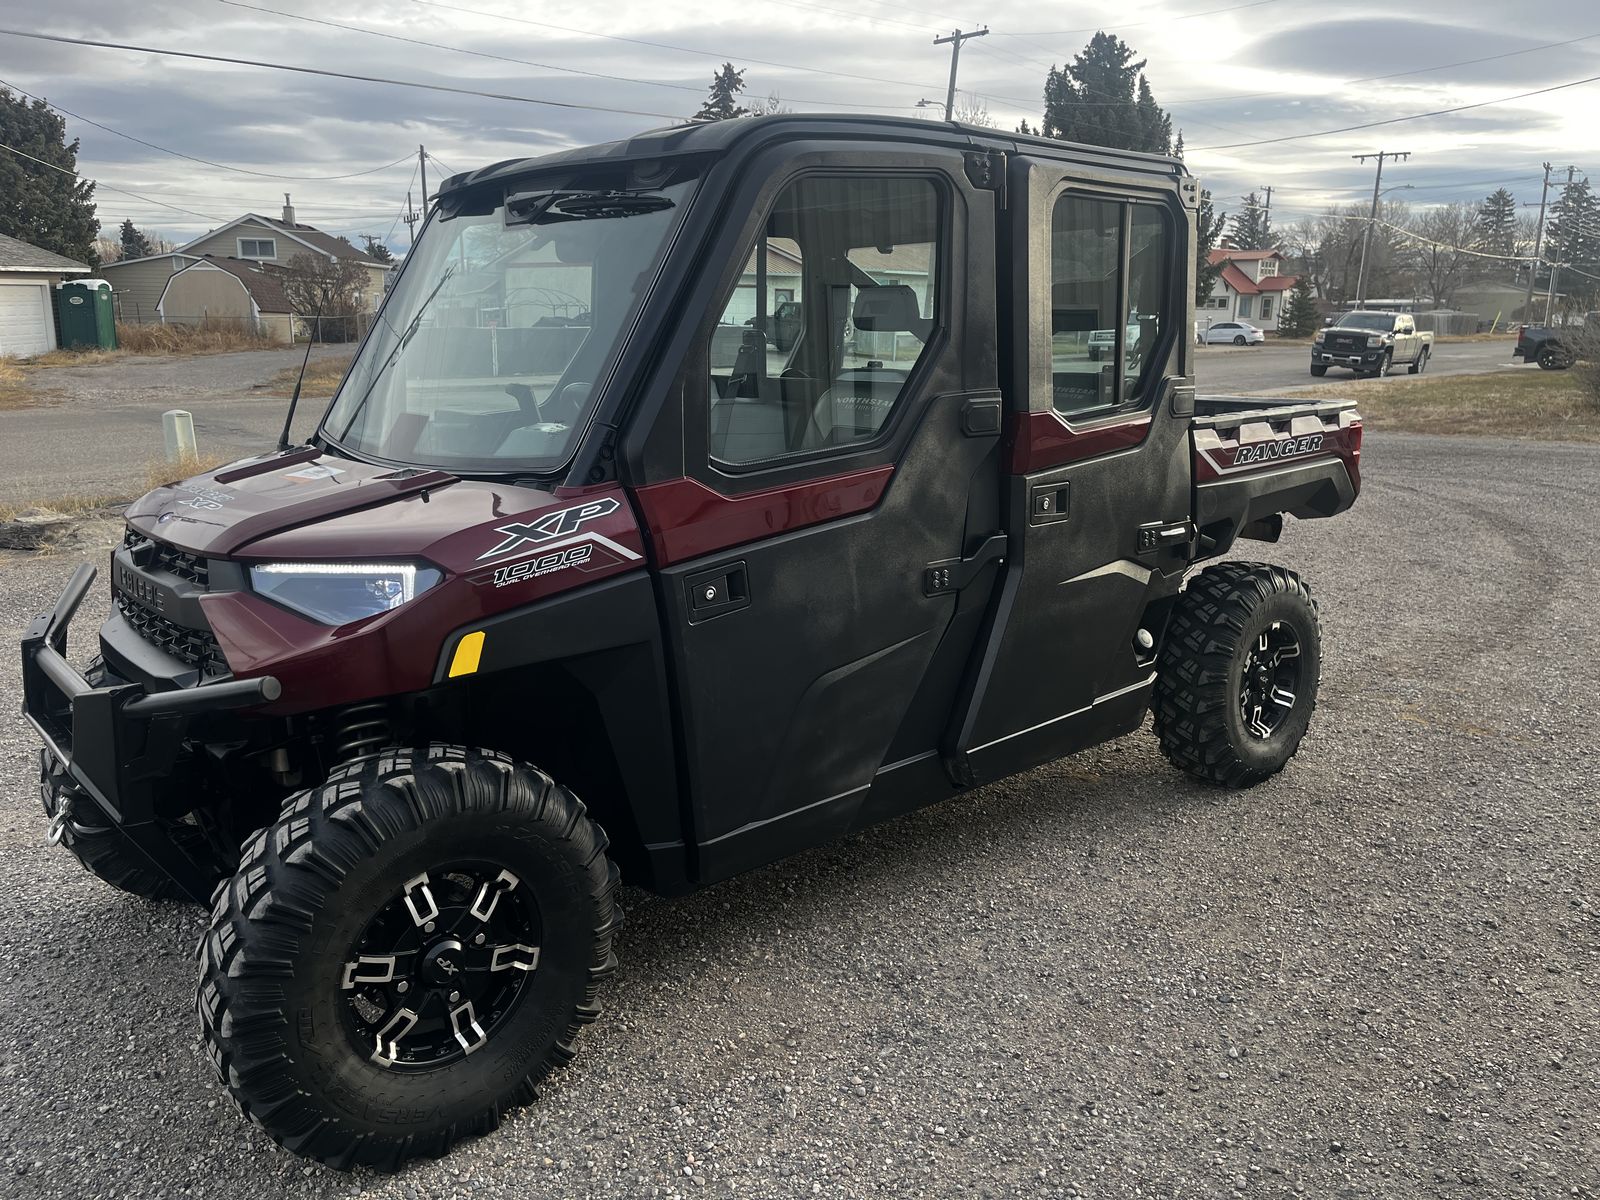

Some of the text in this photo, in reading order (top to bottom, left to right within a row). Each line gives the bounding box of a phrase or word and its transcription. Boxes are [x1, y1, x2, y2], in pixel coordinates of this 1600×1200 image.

[1233, 434, 1324, 465] RANGER
[177, 496, 224, 510] XP
[475, 497, 621, 561] XP
[493, 543, 593, 584] 1000
[496, 557, 591, 588] DUAL OVERHEAD CAM
